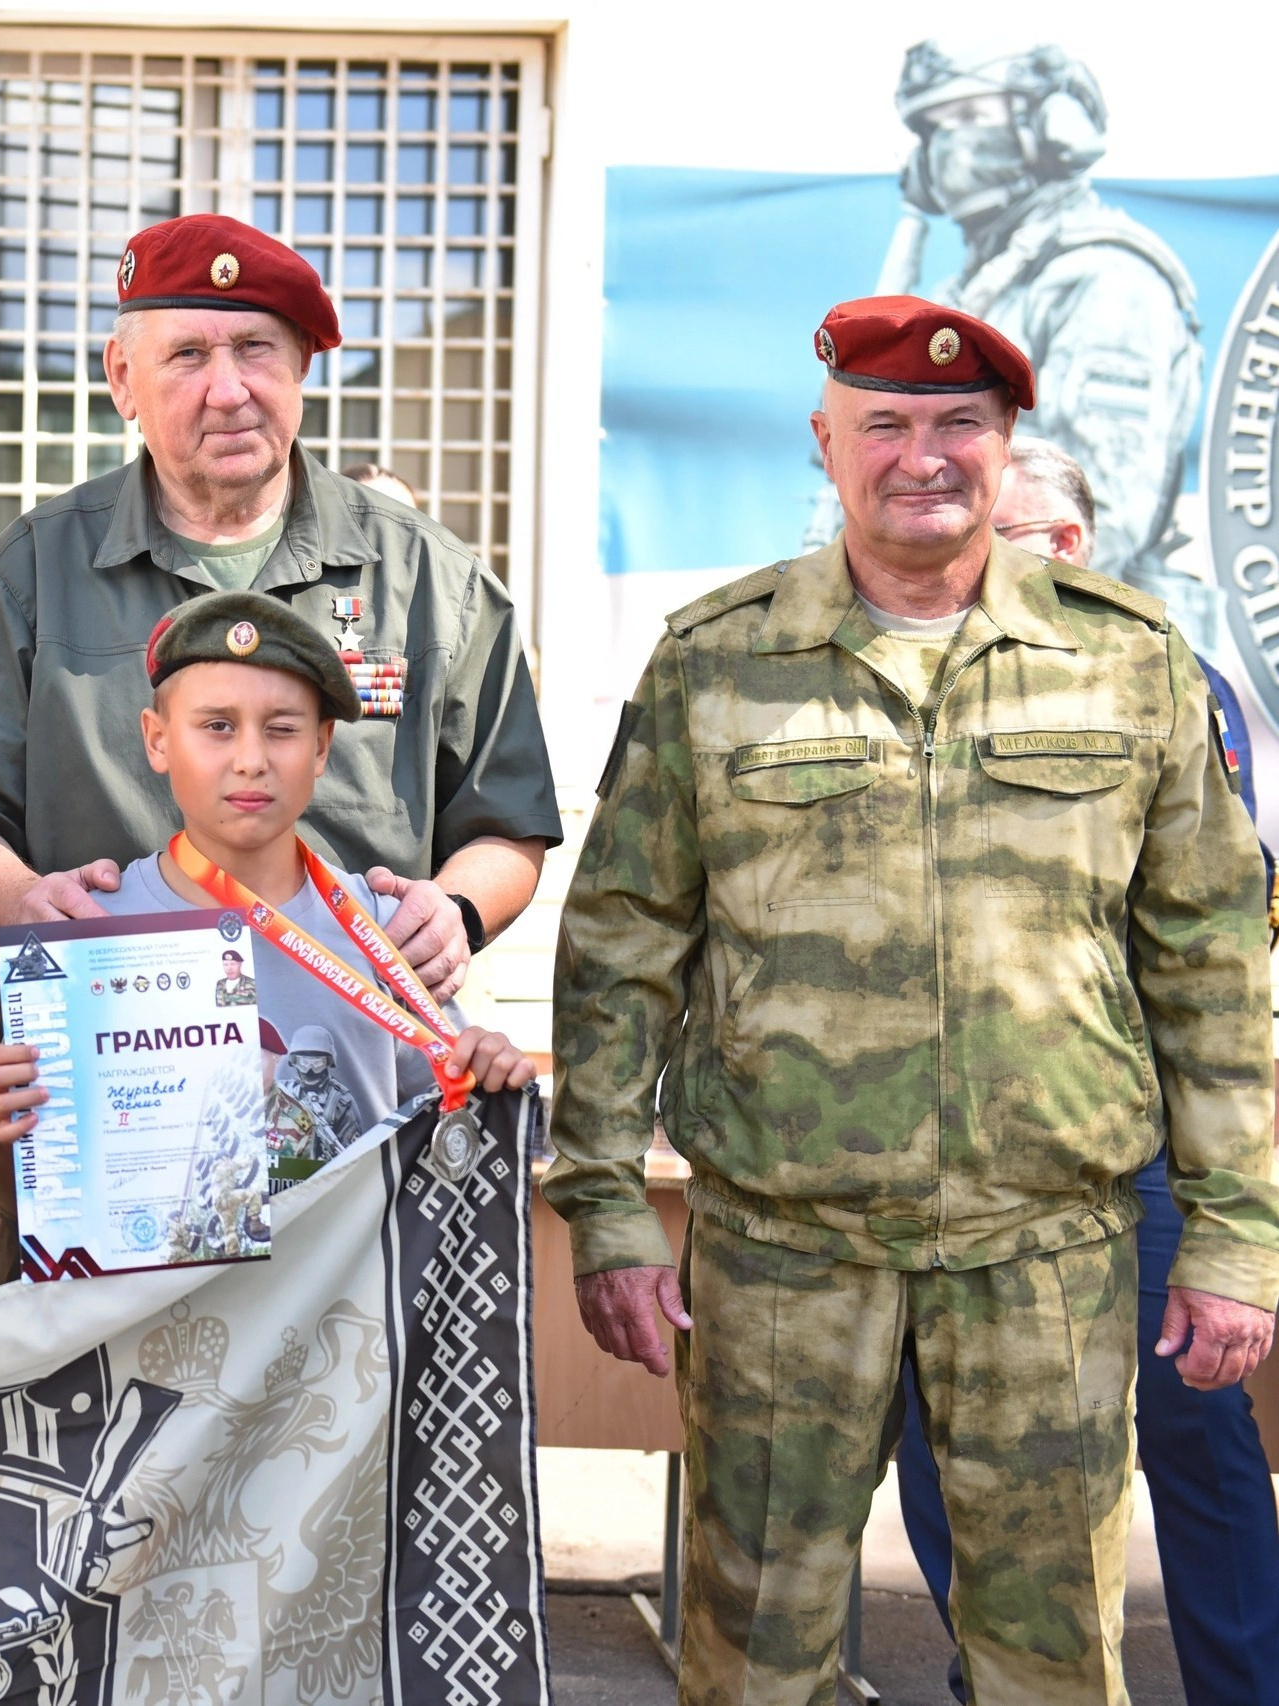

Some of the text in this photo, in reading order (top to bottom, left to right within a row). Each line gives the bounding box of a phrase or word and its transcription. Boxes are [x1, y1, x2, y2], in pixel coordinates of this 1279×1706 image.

[999, 735, 1079, 750] МЕЛИКОВ
[349, 914, 392, 965] ОБЛАСТЬ
[279, 930, 420, 1039] МОСКОВСКАЯ ОБЛАСТЬ
[96, 1022, 244, 1055] ГРАМОТА
[98, 1065, 176, 1079] НАГРАЖДАЕТСЯ
[107, 1078, 187, 1101] Журавлев
[112, 1099, 162, 1111] Денис
